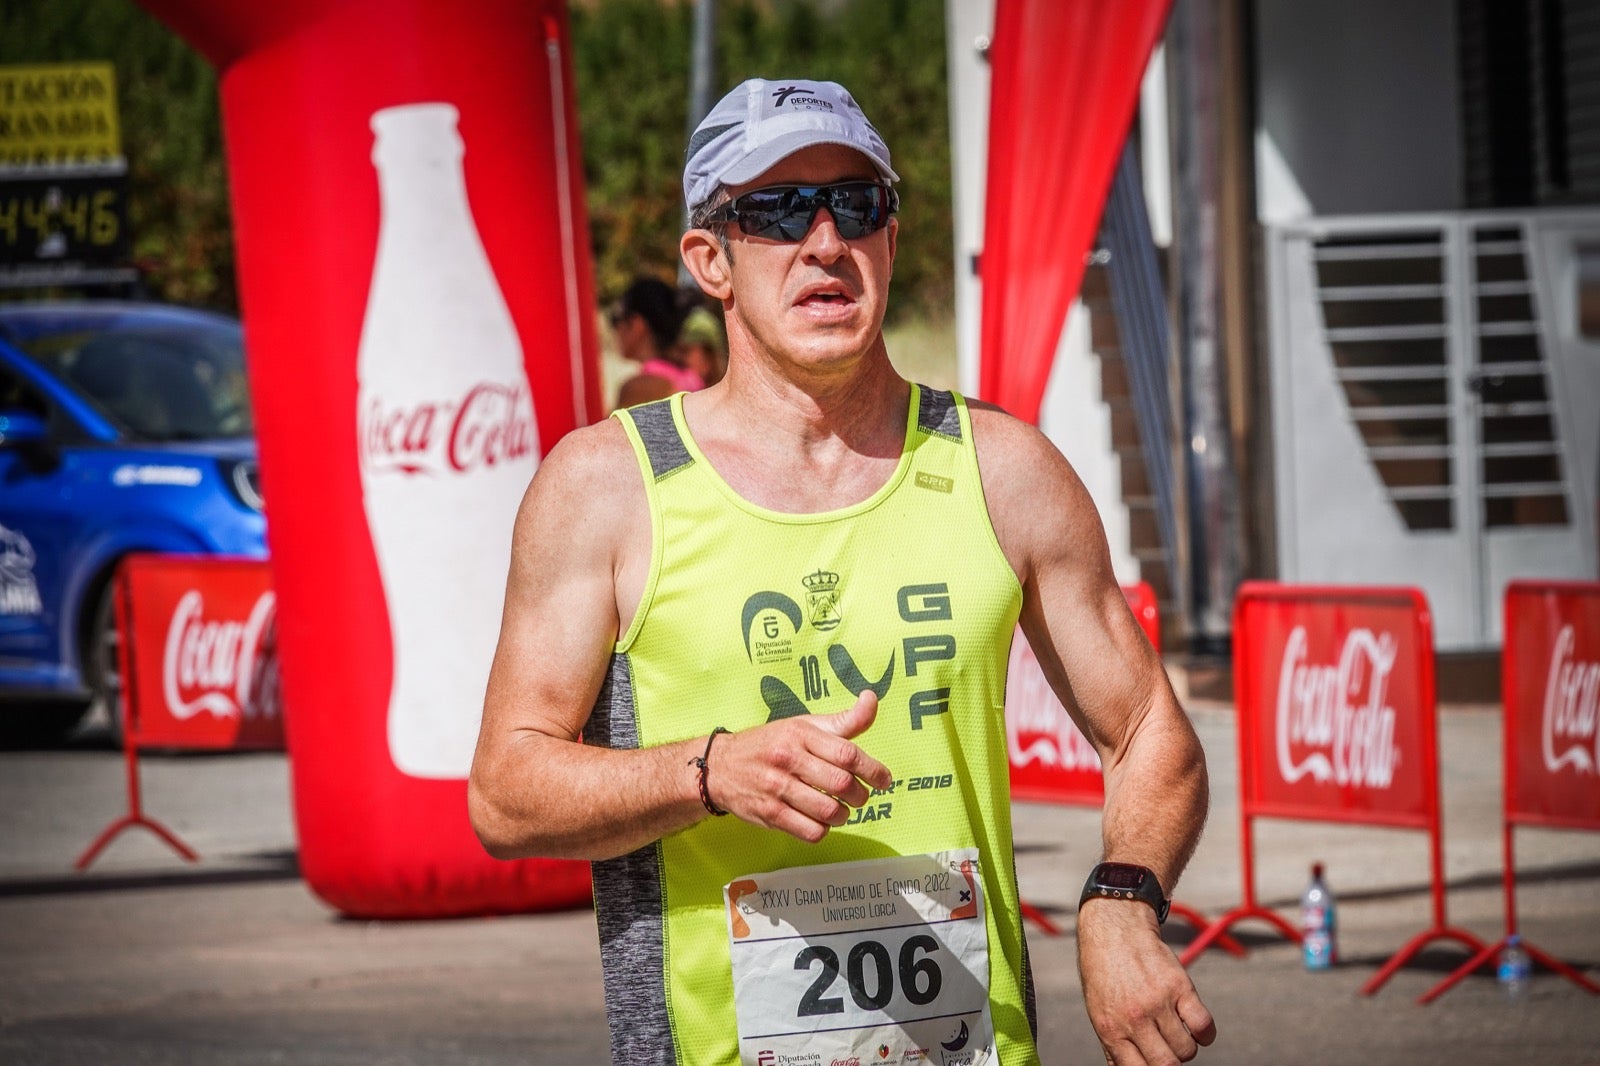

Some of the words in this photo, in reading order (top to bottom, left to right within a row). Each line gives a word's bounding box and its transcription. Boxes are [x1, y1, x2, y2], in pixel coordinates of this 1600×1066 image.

[790, 97, 833, 109] DEPORTES
[755, 640, 792, 650] Diputación
[765, 647, 793, 656] Granada
[907, 774, 953, 791] 2018
[924, 871, 950, 893] 2022
[793, 934, 943, 1018] 206
[778, 1053, 821, 1064] Diputación
